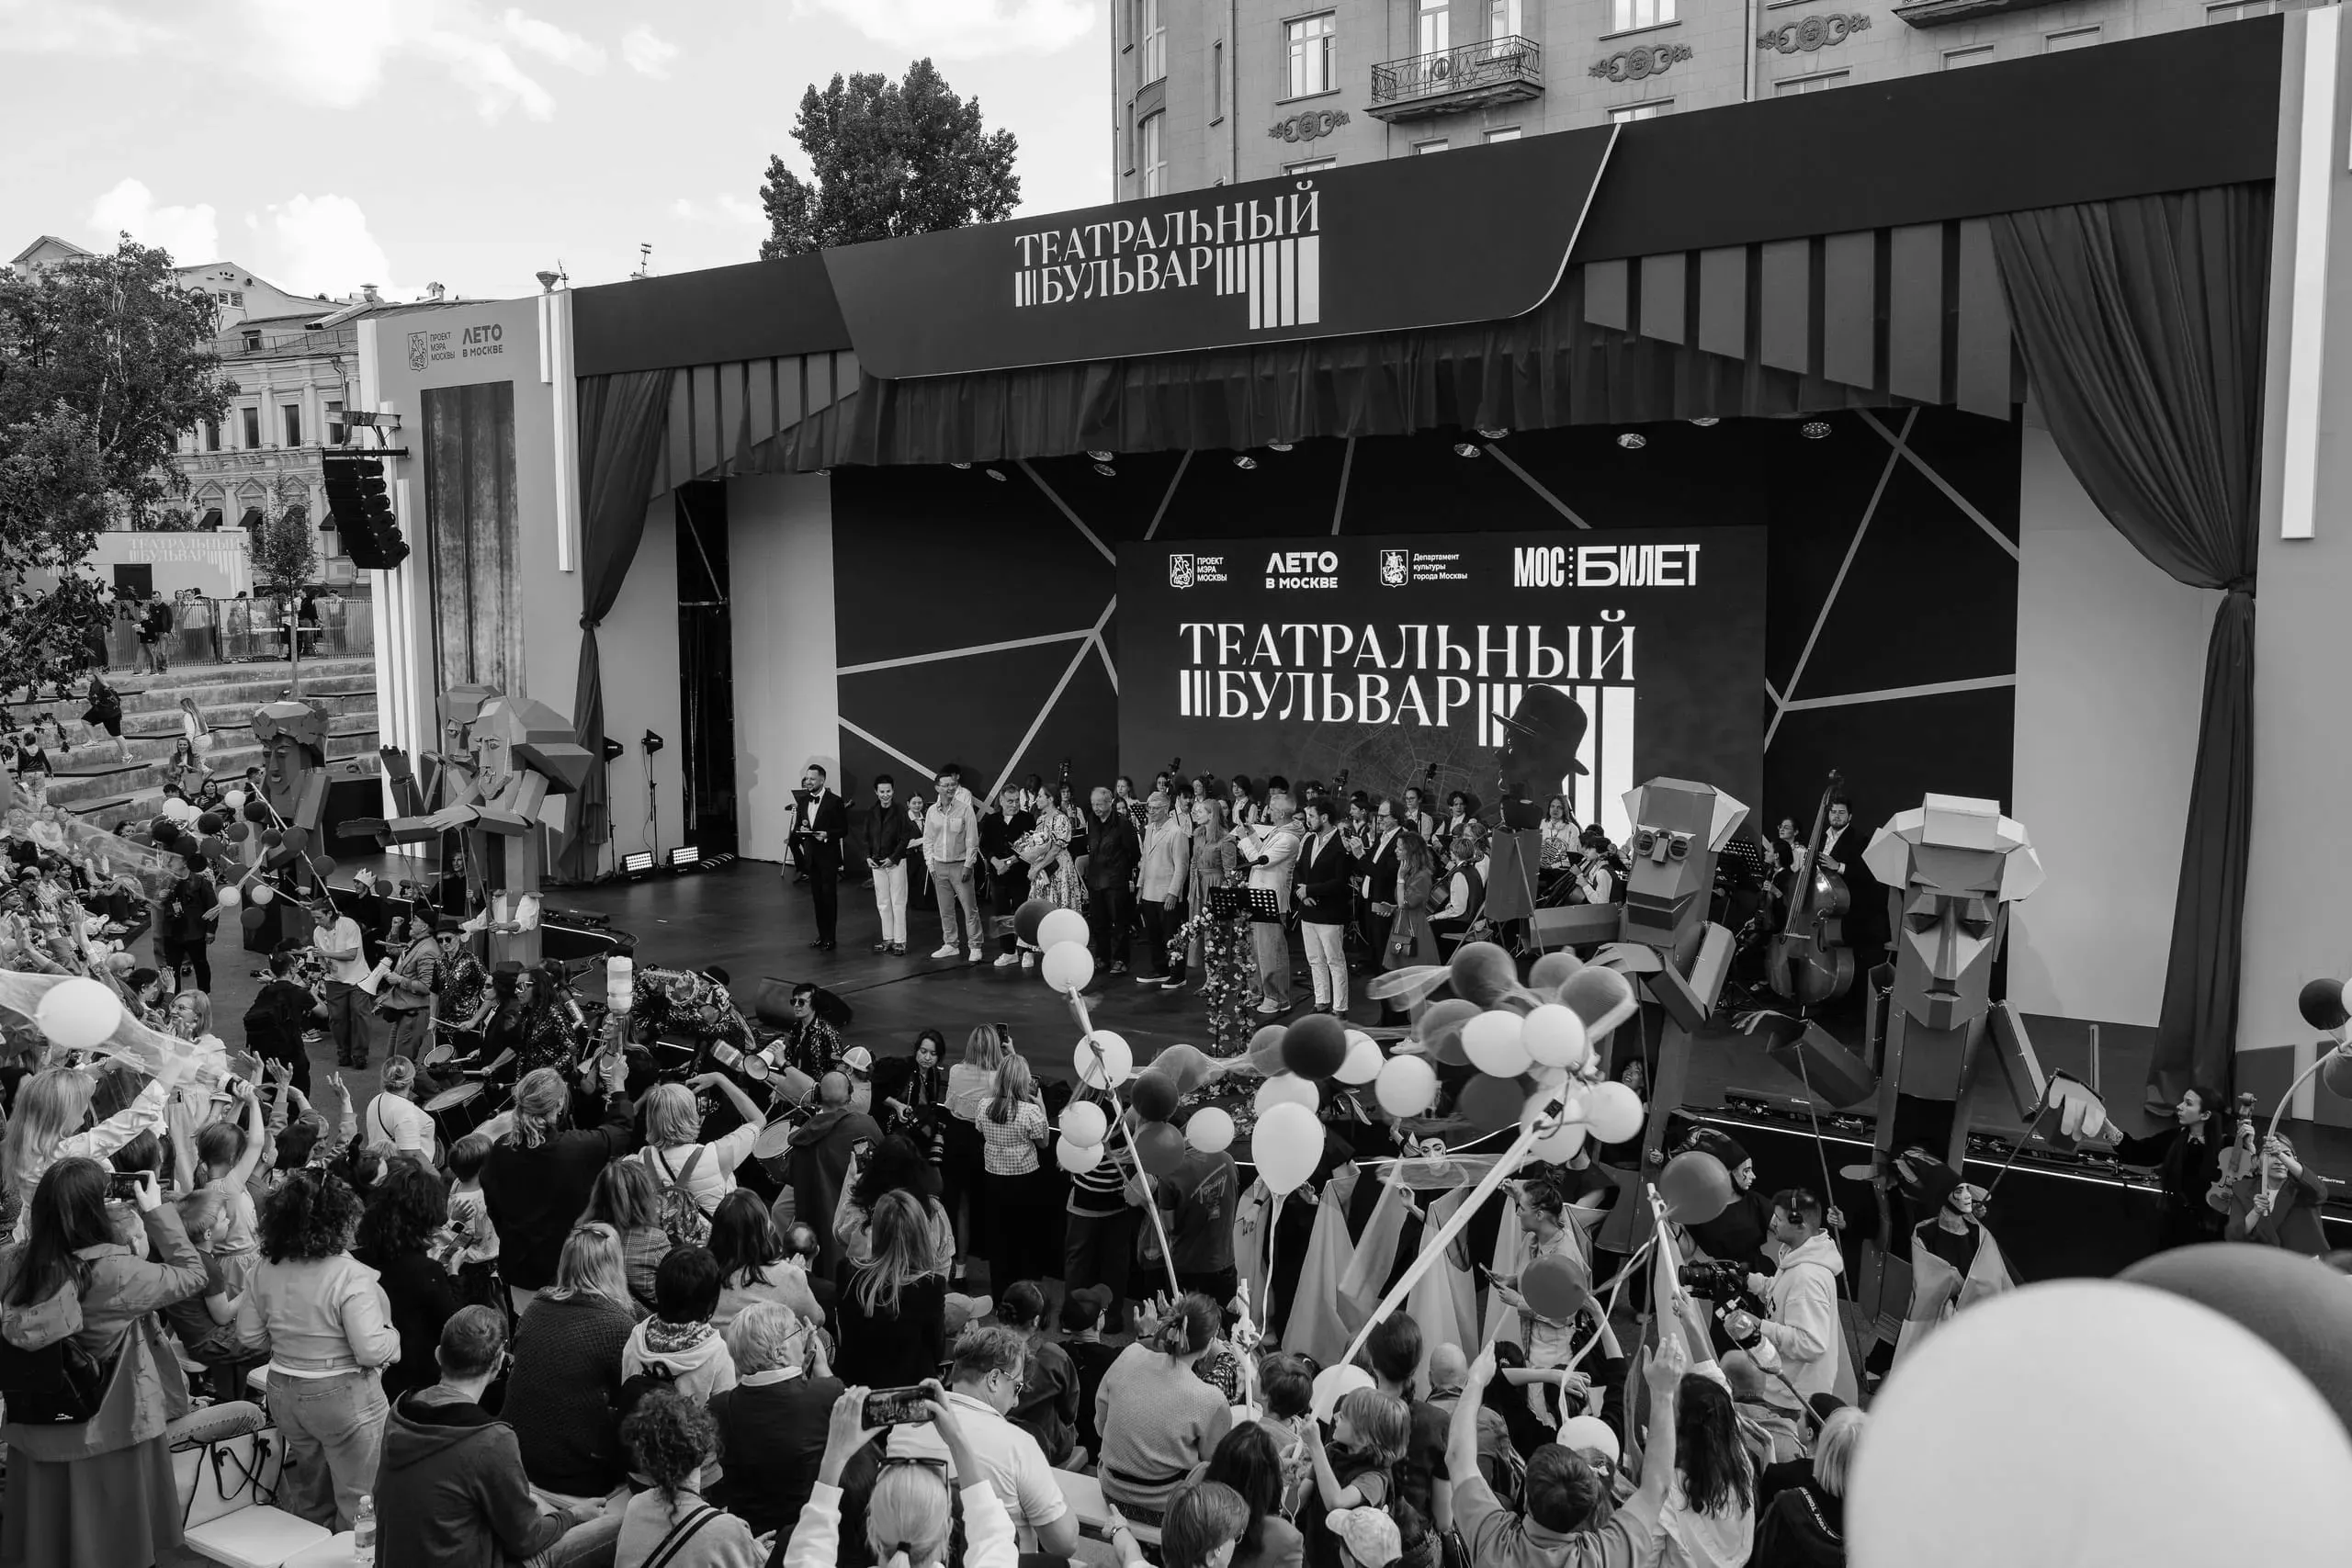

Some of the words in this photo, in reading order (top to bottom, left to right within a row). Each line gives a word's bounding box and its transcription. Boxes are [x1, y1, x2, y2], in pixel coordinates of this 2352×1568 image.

[1014, 179, 1320, 267] ТЕАТРАЛЬНЫЙ
[1041, 246, 1214, 305] БУЛЬВАР
[430, 331, 452, 343] ПРОЕКТ
[462, 323, 503, 345] ЛЕТО
[430, 342, 447, 352] МЭРА
[462, 348, 469, 358] В
[469, 344, 503, 357] МОСКВЕ
[431, 350, 456, 361] МОСКВЫ
[130, 535, 241, 550] ТЕАТРАЛЬНЫЙ
[1196, 557, 1225, 565] ПРОЕКТ
[1265, 551, 1339, 574] ЛЕТО
[1413, 553, 1460, 562] Департамент
[1196, 565, 1217, 573] МЭРА
[1413, 563, 1446, 572] культуры
[1196, 573, 1227, 581] МОСКВЫ
[1413, 572, 1439, 581] города
[1439, 571, 1468, 580] Москвы
[1265, 577, 1275, 589] В
[1278, 577, 1339, 589] МОСКВЕ
[1179, 609, 1636, 681] ТЕАТРАЛЬНЫЙ
[1217, 670, 1472, 727] БУЛЬВАР
